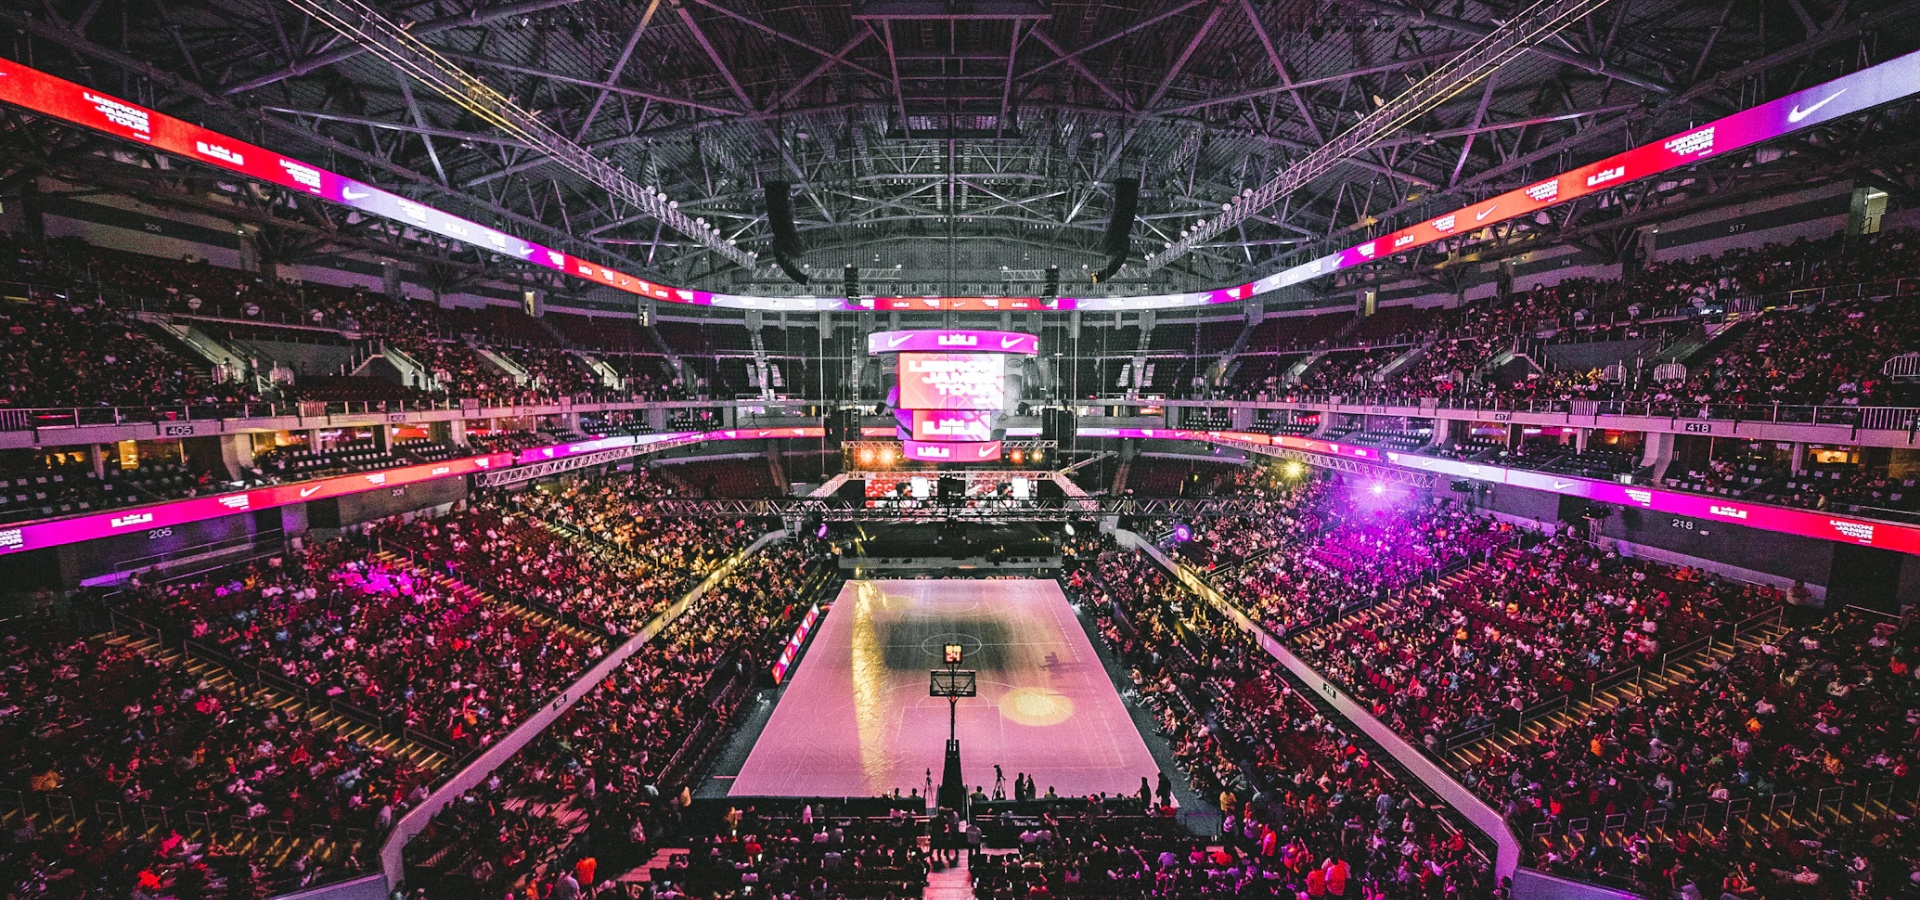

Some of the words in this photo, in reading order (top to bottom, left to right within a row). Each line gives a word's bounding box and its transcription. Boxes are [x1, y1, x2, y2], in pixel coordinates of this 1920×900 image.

[83, 92, 149, 119] LEBRON
[94, 105, 149, 126] JAMES
[106, 112, 150, 133] TOUR
[1664, 126, 1715, 149] LEBRON
[1671, 133, 1714, 152] JAMES
[1678, 139, 1714, 156] TOUR
[1729, 223, 1746, 233] 517
[908, 360, 996, 372] LEBRON
[922, 372, 997, 384] JAMES
[935, 383, 997, 395] TOUR
[168, 426, 191, 435] 405
[1687, 423, 1709, 433] 418
[1672, 518, 1694, 530] 218
[1829, 520, 1874, 531] LEBRON
[149, 527, 172, 539] 205
[1841, 529, 1872, 539] TOUR
[946, 651, 960, 662] 24
